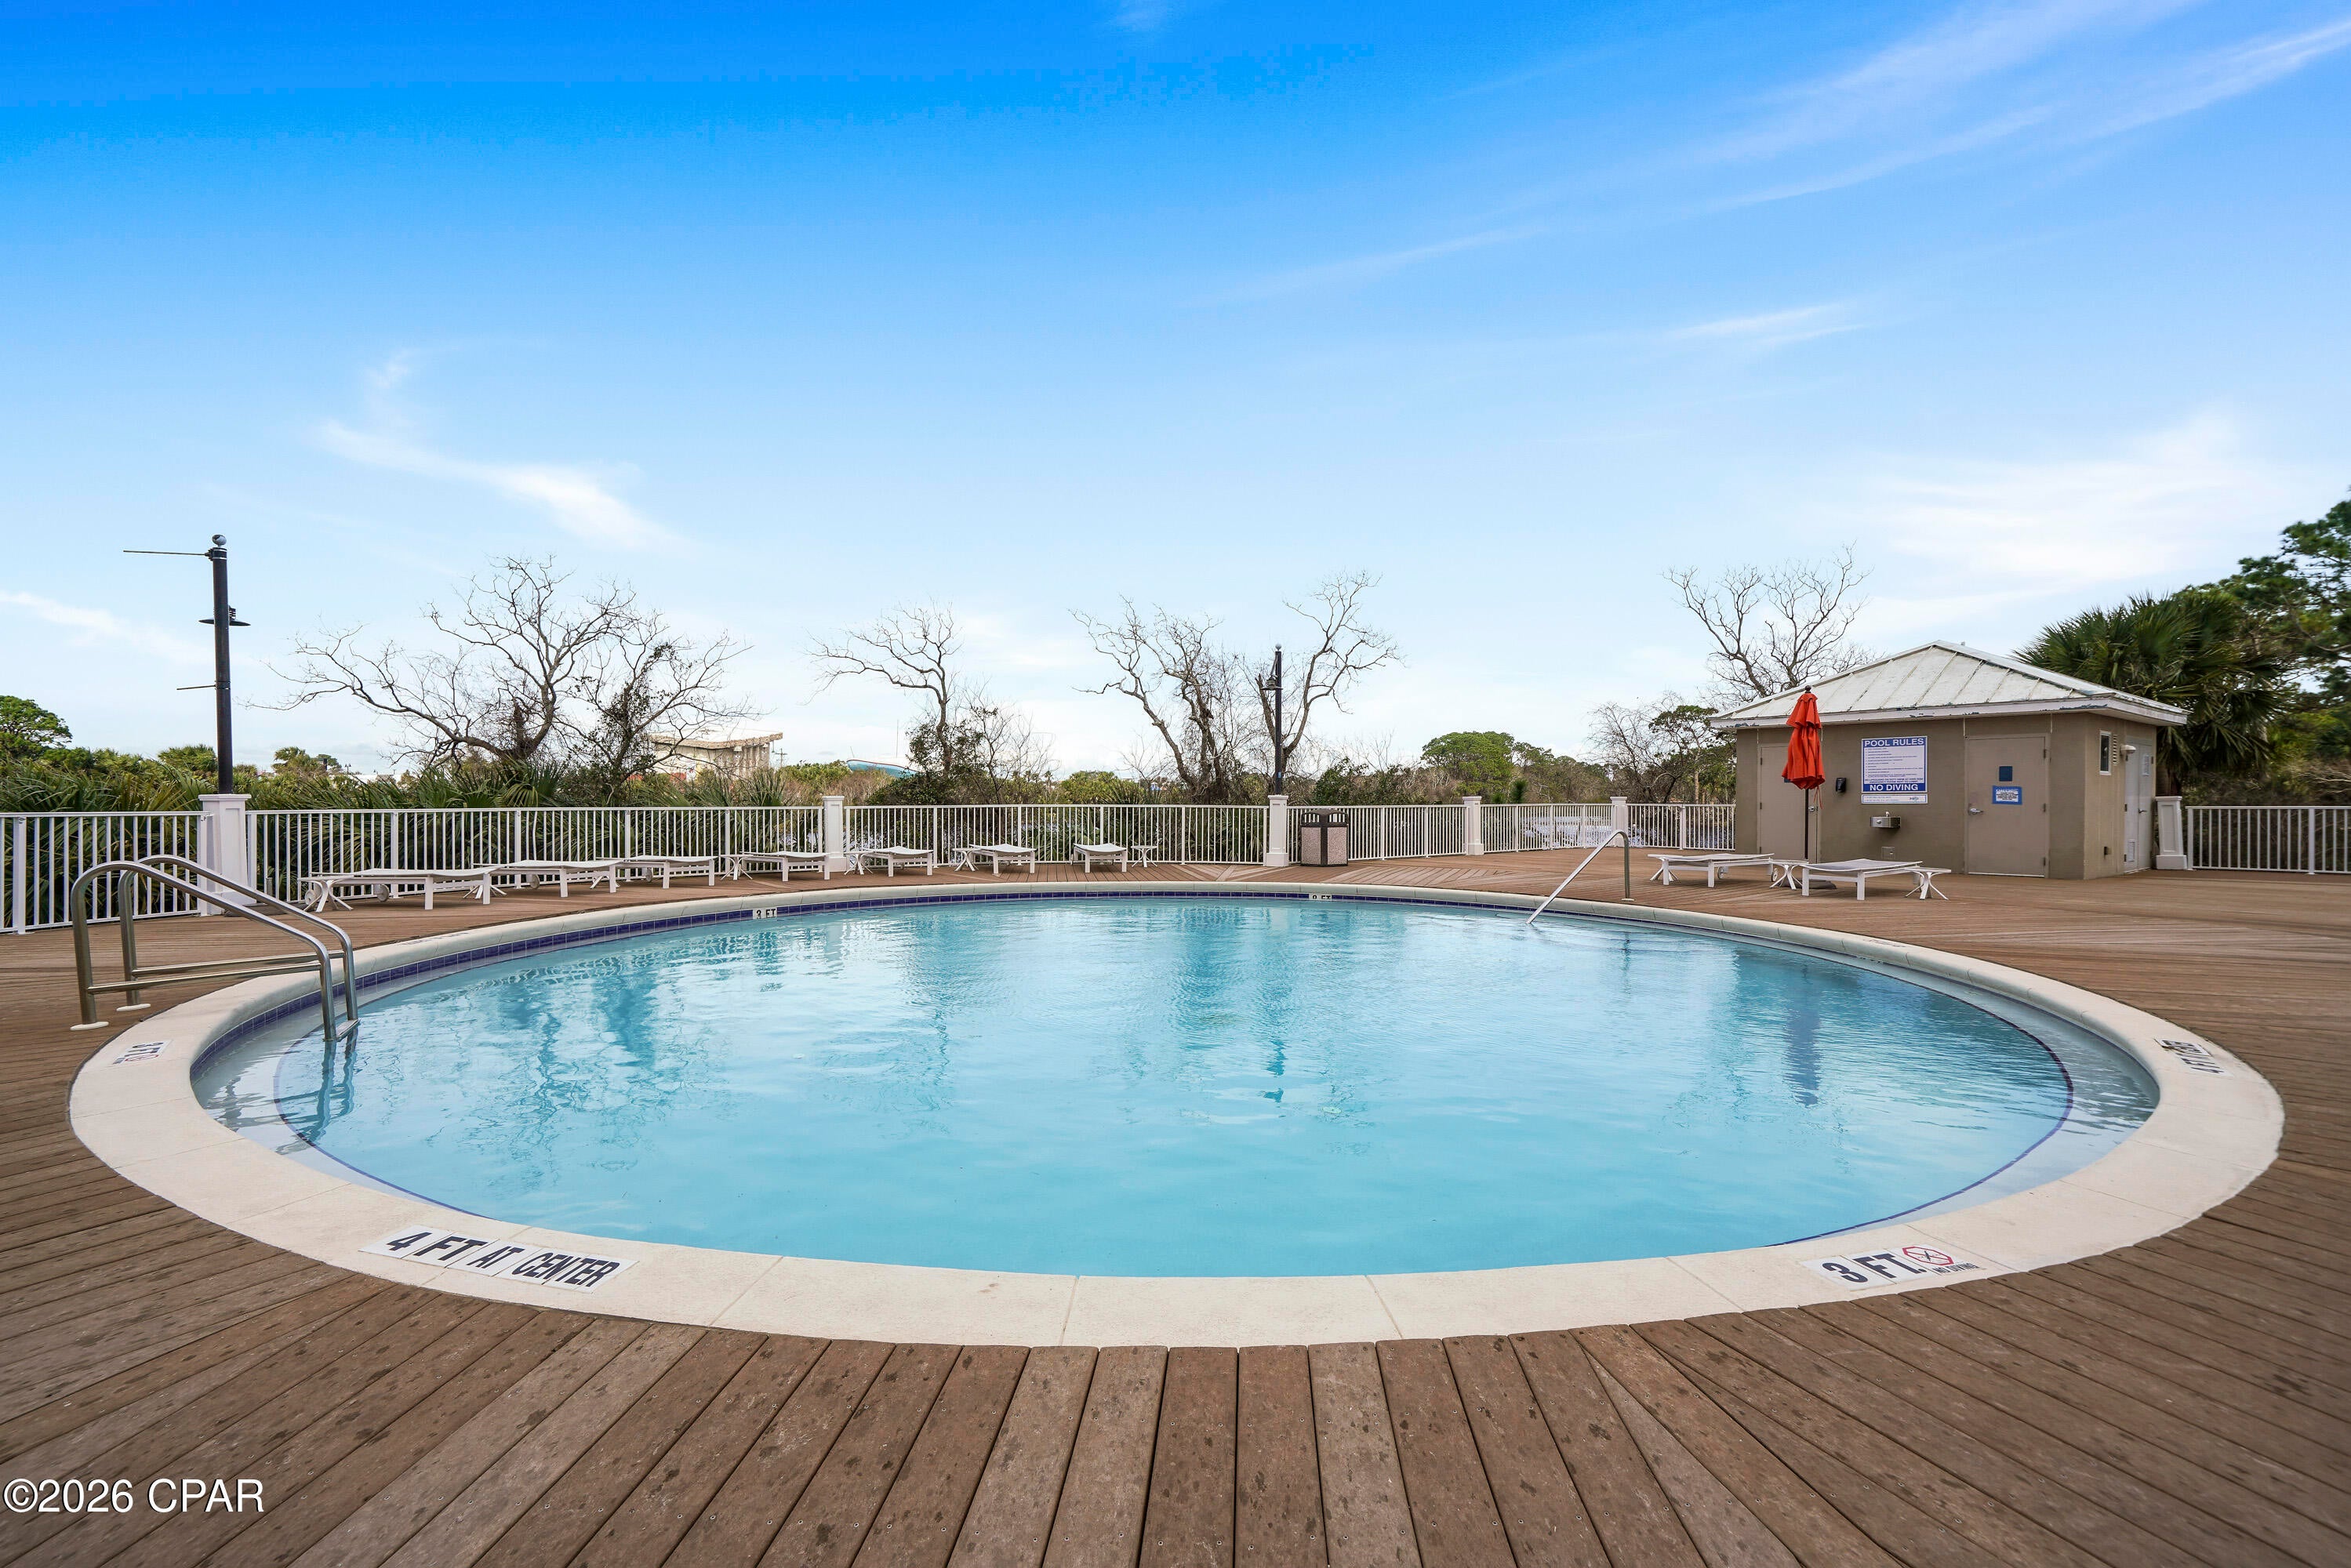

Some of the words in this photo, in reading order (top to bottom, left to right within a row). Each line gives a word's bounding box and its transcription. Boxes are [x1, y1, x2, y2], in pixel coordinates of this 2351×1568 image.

[385, 1232, 433, 1252] 4
[412, 1236, 490, 1261] FT
[467, 1246, 525, 1269] AT
[511, 1252, 621, 1287] CENTER
[1822, 1261, 1869, 1283] 3
[1852, 1253, 1928, 1279] FT.
